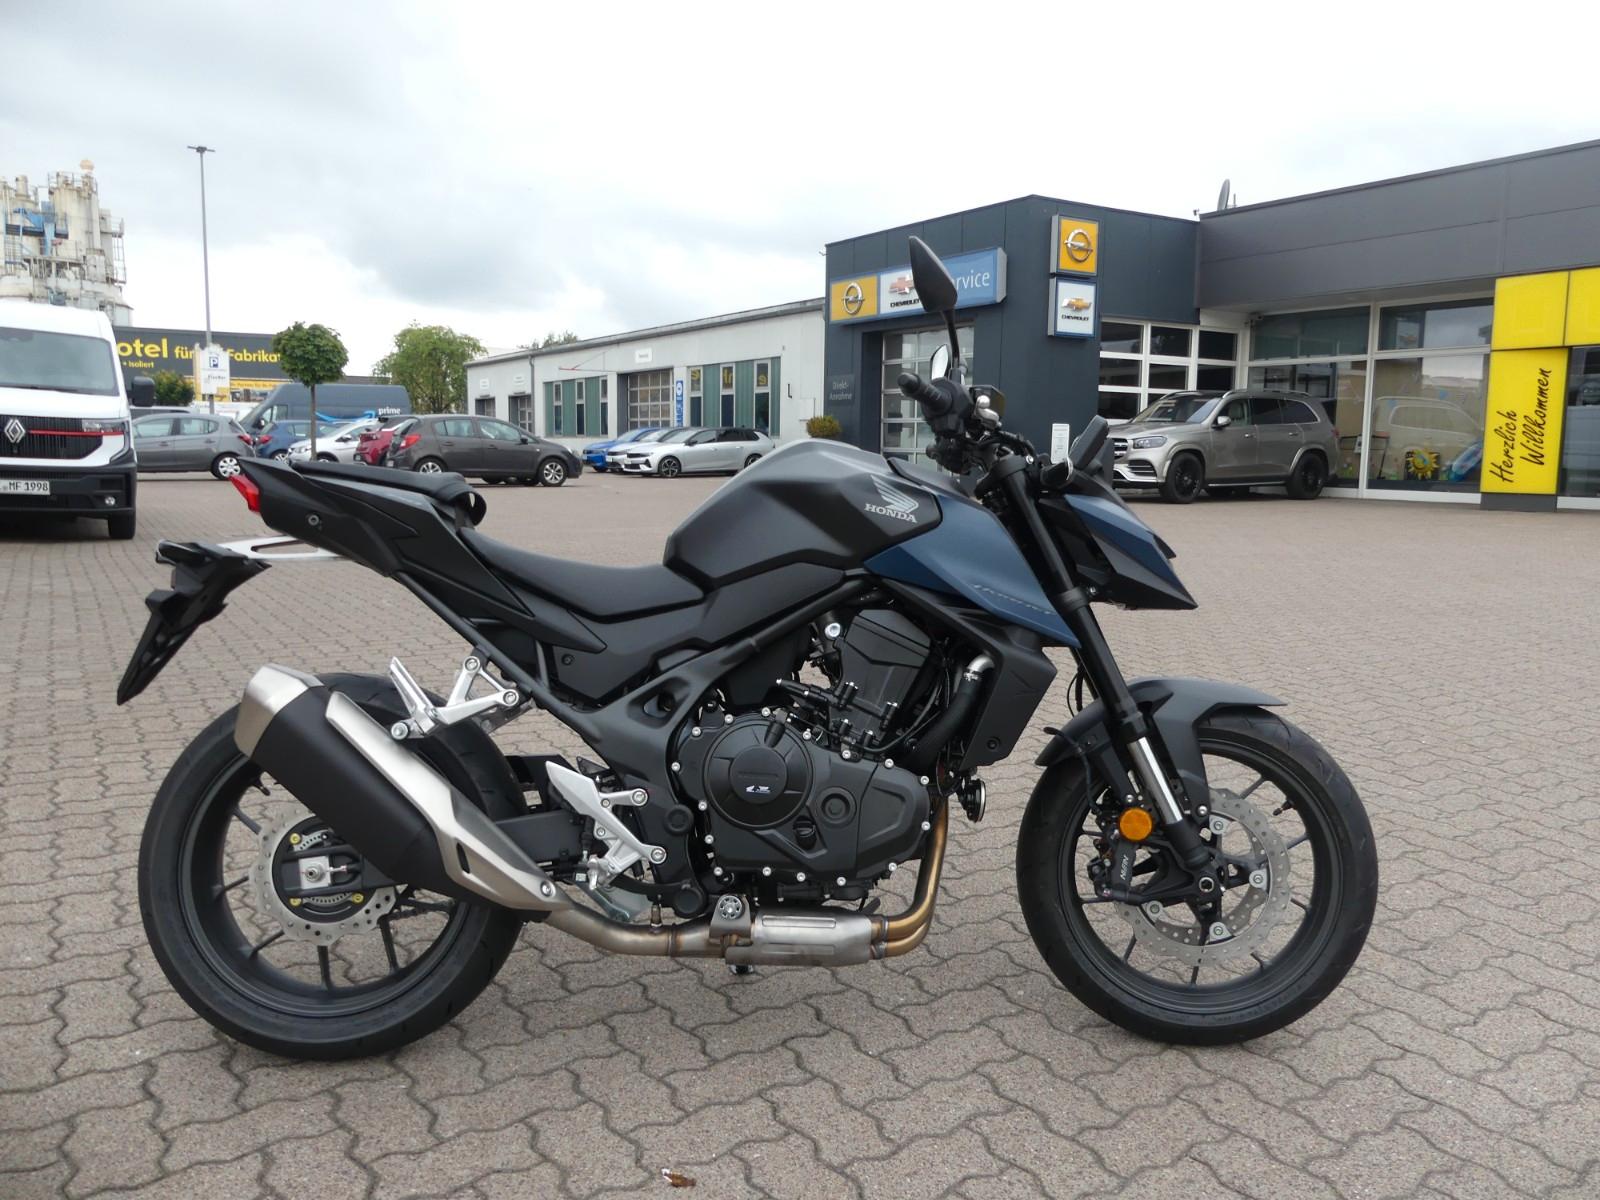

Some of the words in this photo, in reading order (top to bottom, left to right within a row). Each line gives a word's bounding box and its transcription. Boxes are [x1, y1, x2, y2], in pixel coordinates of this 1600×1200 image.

[953, 269, 991, 290] rvice
[174, 345, 194, 359] für
[378, 405, 401, 416] prime
[1519, 367, 1552, 466] Willkommen
[1489, 409, 1518, 484] Herzlich
[24, 481, 48, 491] 1998
[864, 503, 917, 523] HONDA
